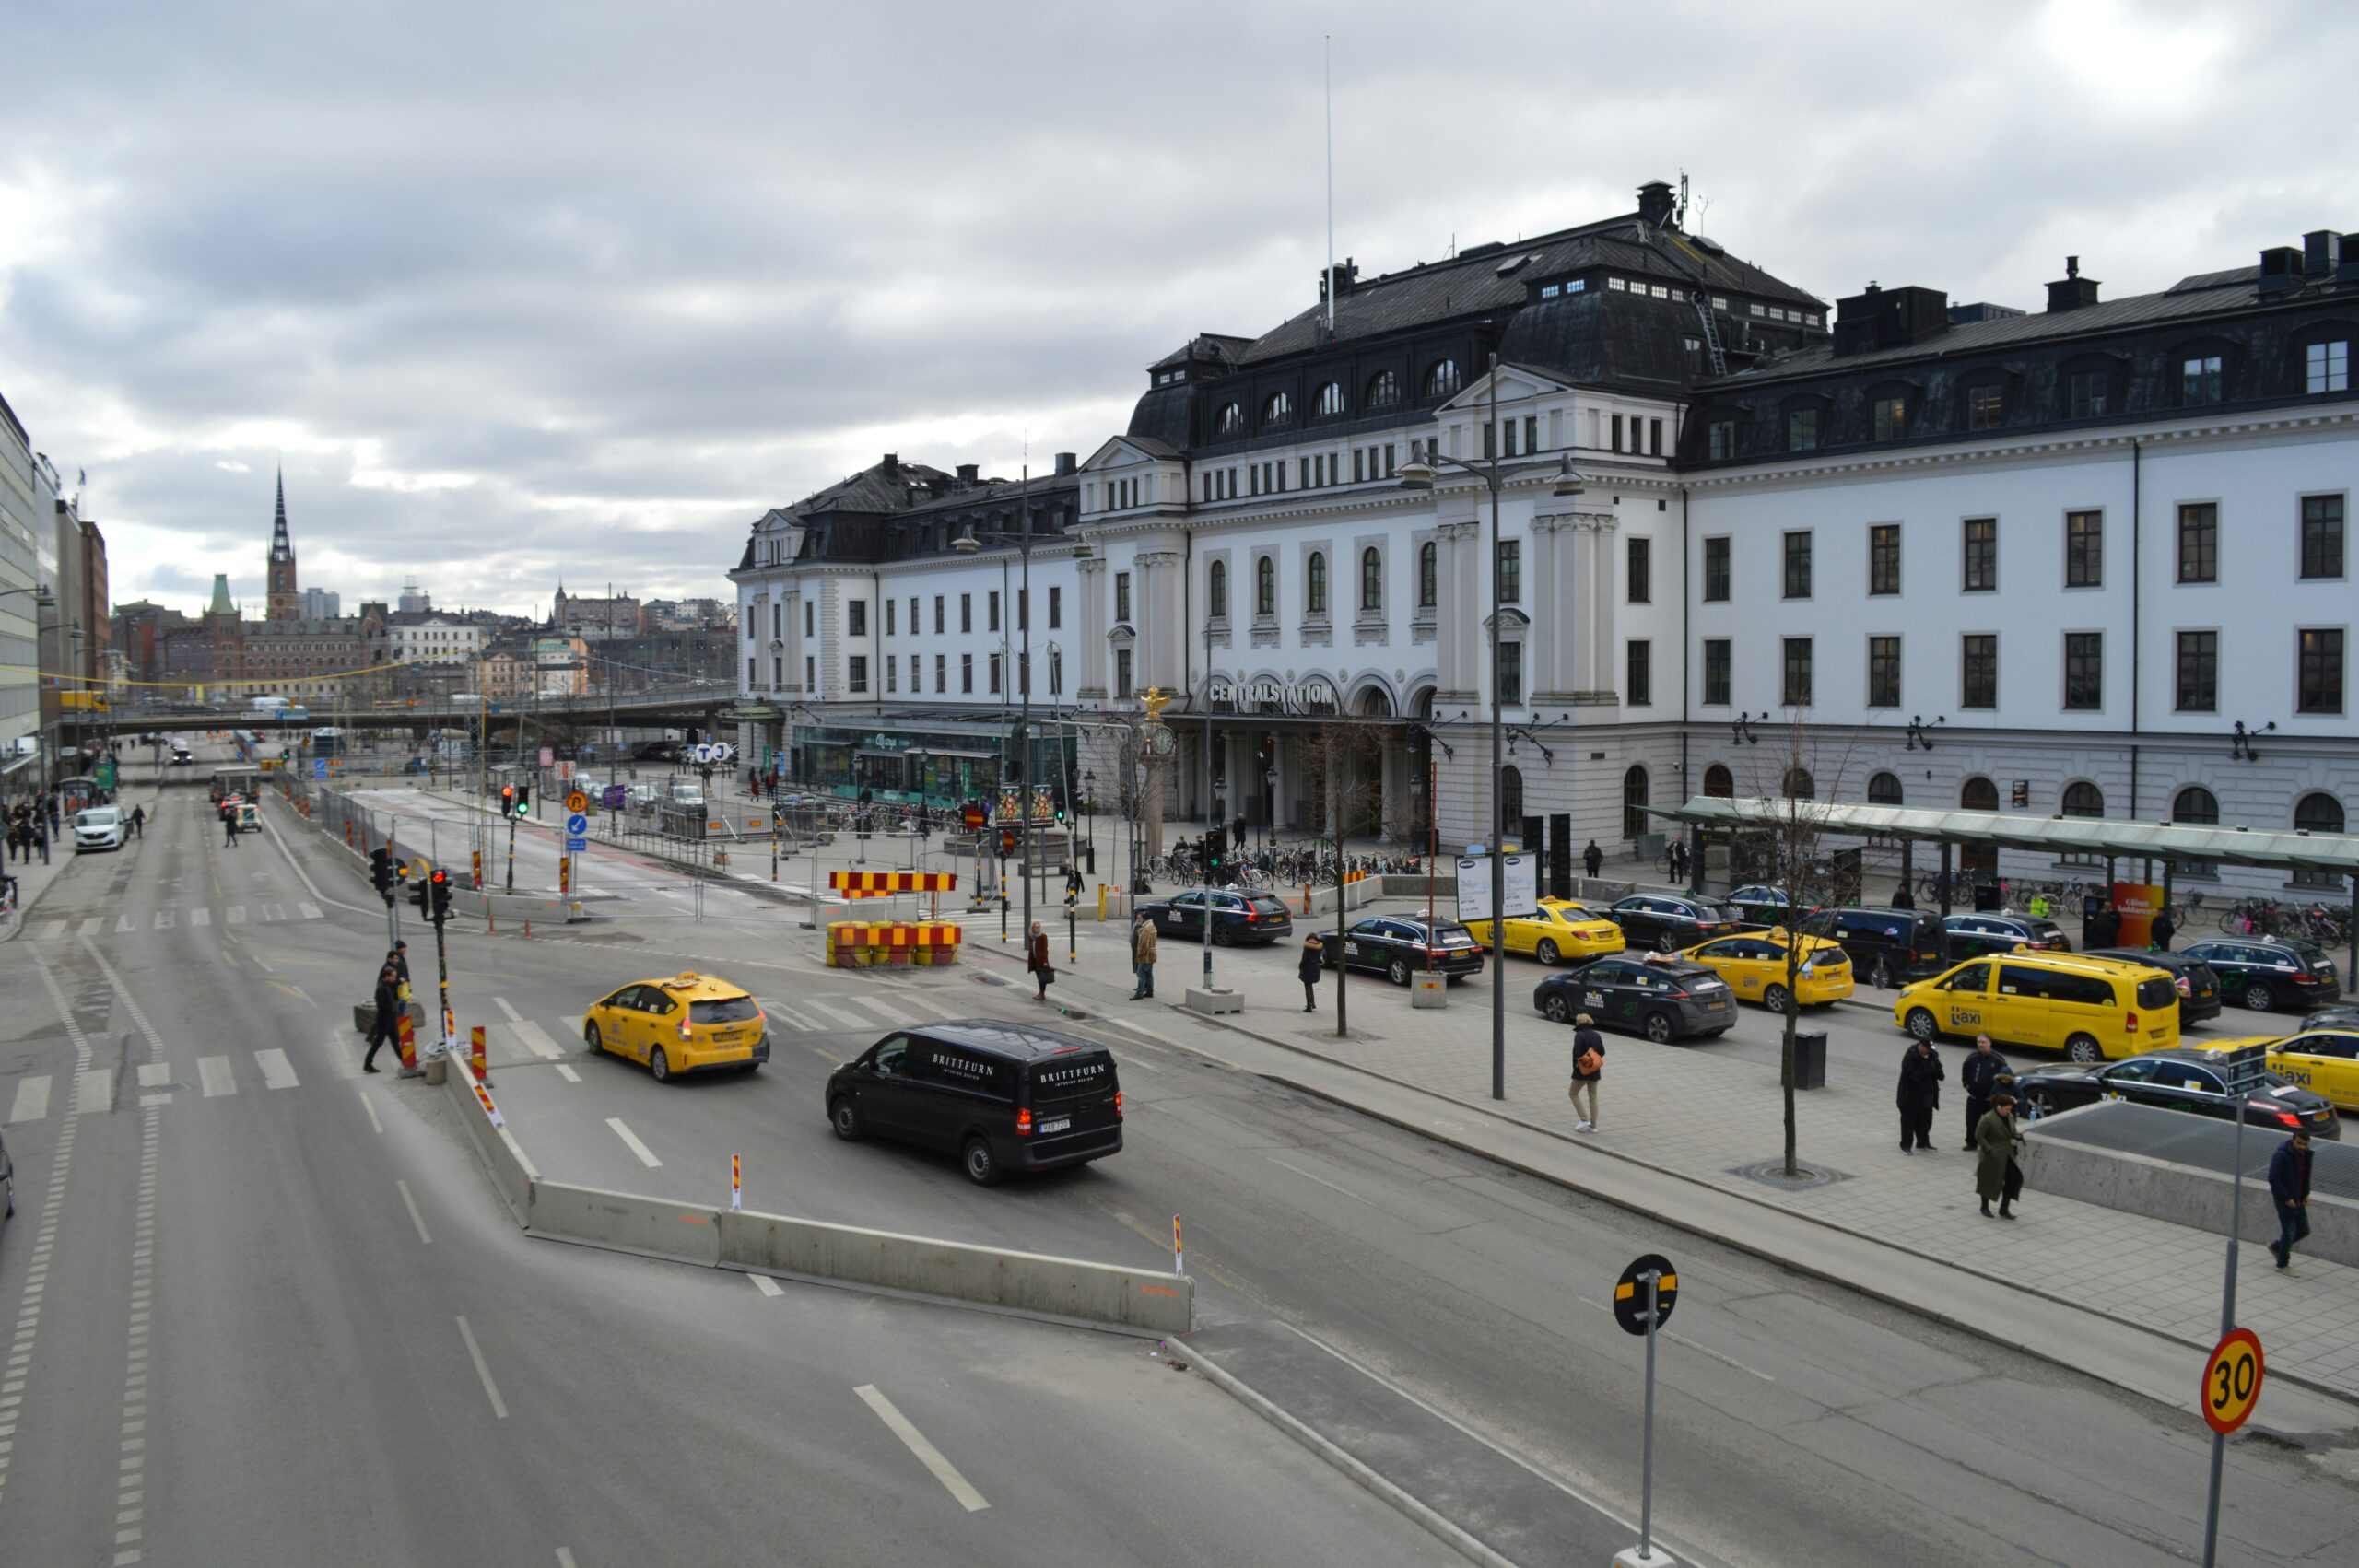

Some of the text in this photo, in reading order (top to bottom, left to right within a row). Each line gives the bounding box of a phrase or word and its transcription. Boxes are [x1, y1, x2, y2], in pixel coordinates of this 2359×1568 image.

[1209, 685, 1332, 704] CENTRALSTATION
[933, 1053, 994, 1076] BRITTFURN
[1040, 1064, 1105, 1083] BRITTFURN
[2212, 1353, 2255, 1410] 30
